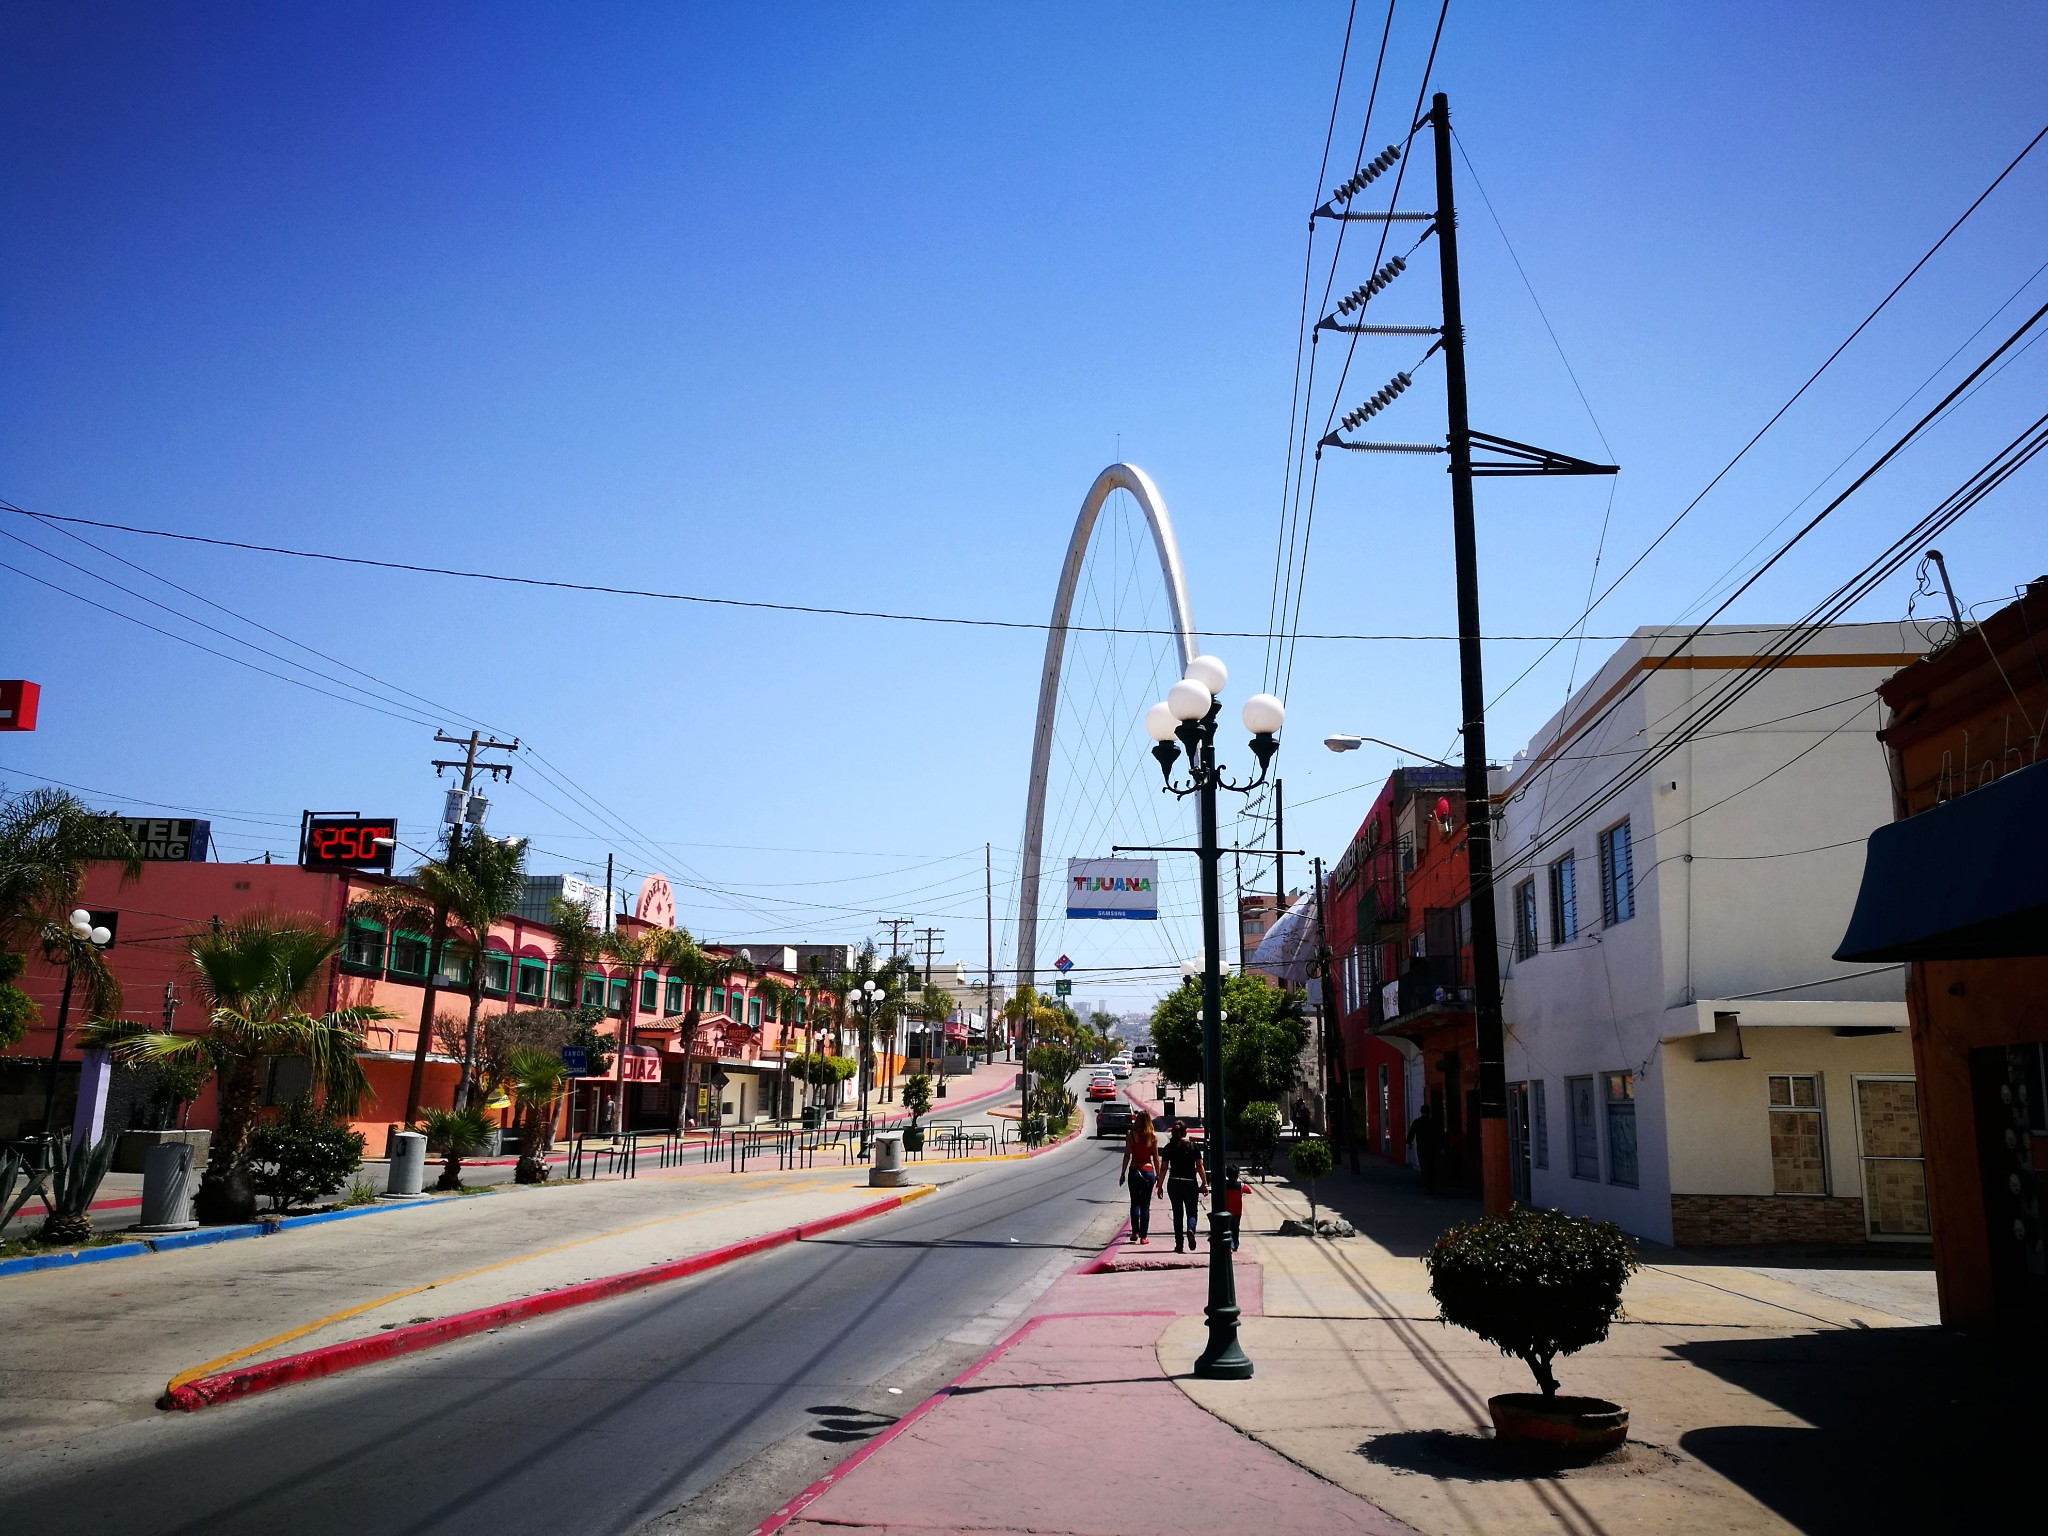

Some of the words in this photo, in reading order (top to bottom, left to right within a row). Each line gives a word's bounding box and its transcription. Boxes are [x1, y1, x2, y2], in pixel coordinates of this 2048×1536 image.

[1073, 876, 1152, 892] TIJUANA
[728, 1029, 749, 1038] MOTEL
[623, 1057, 657, 1080] DIAZ
